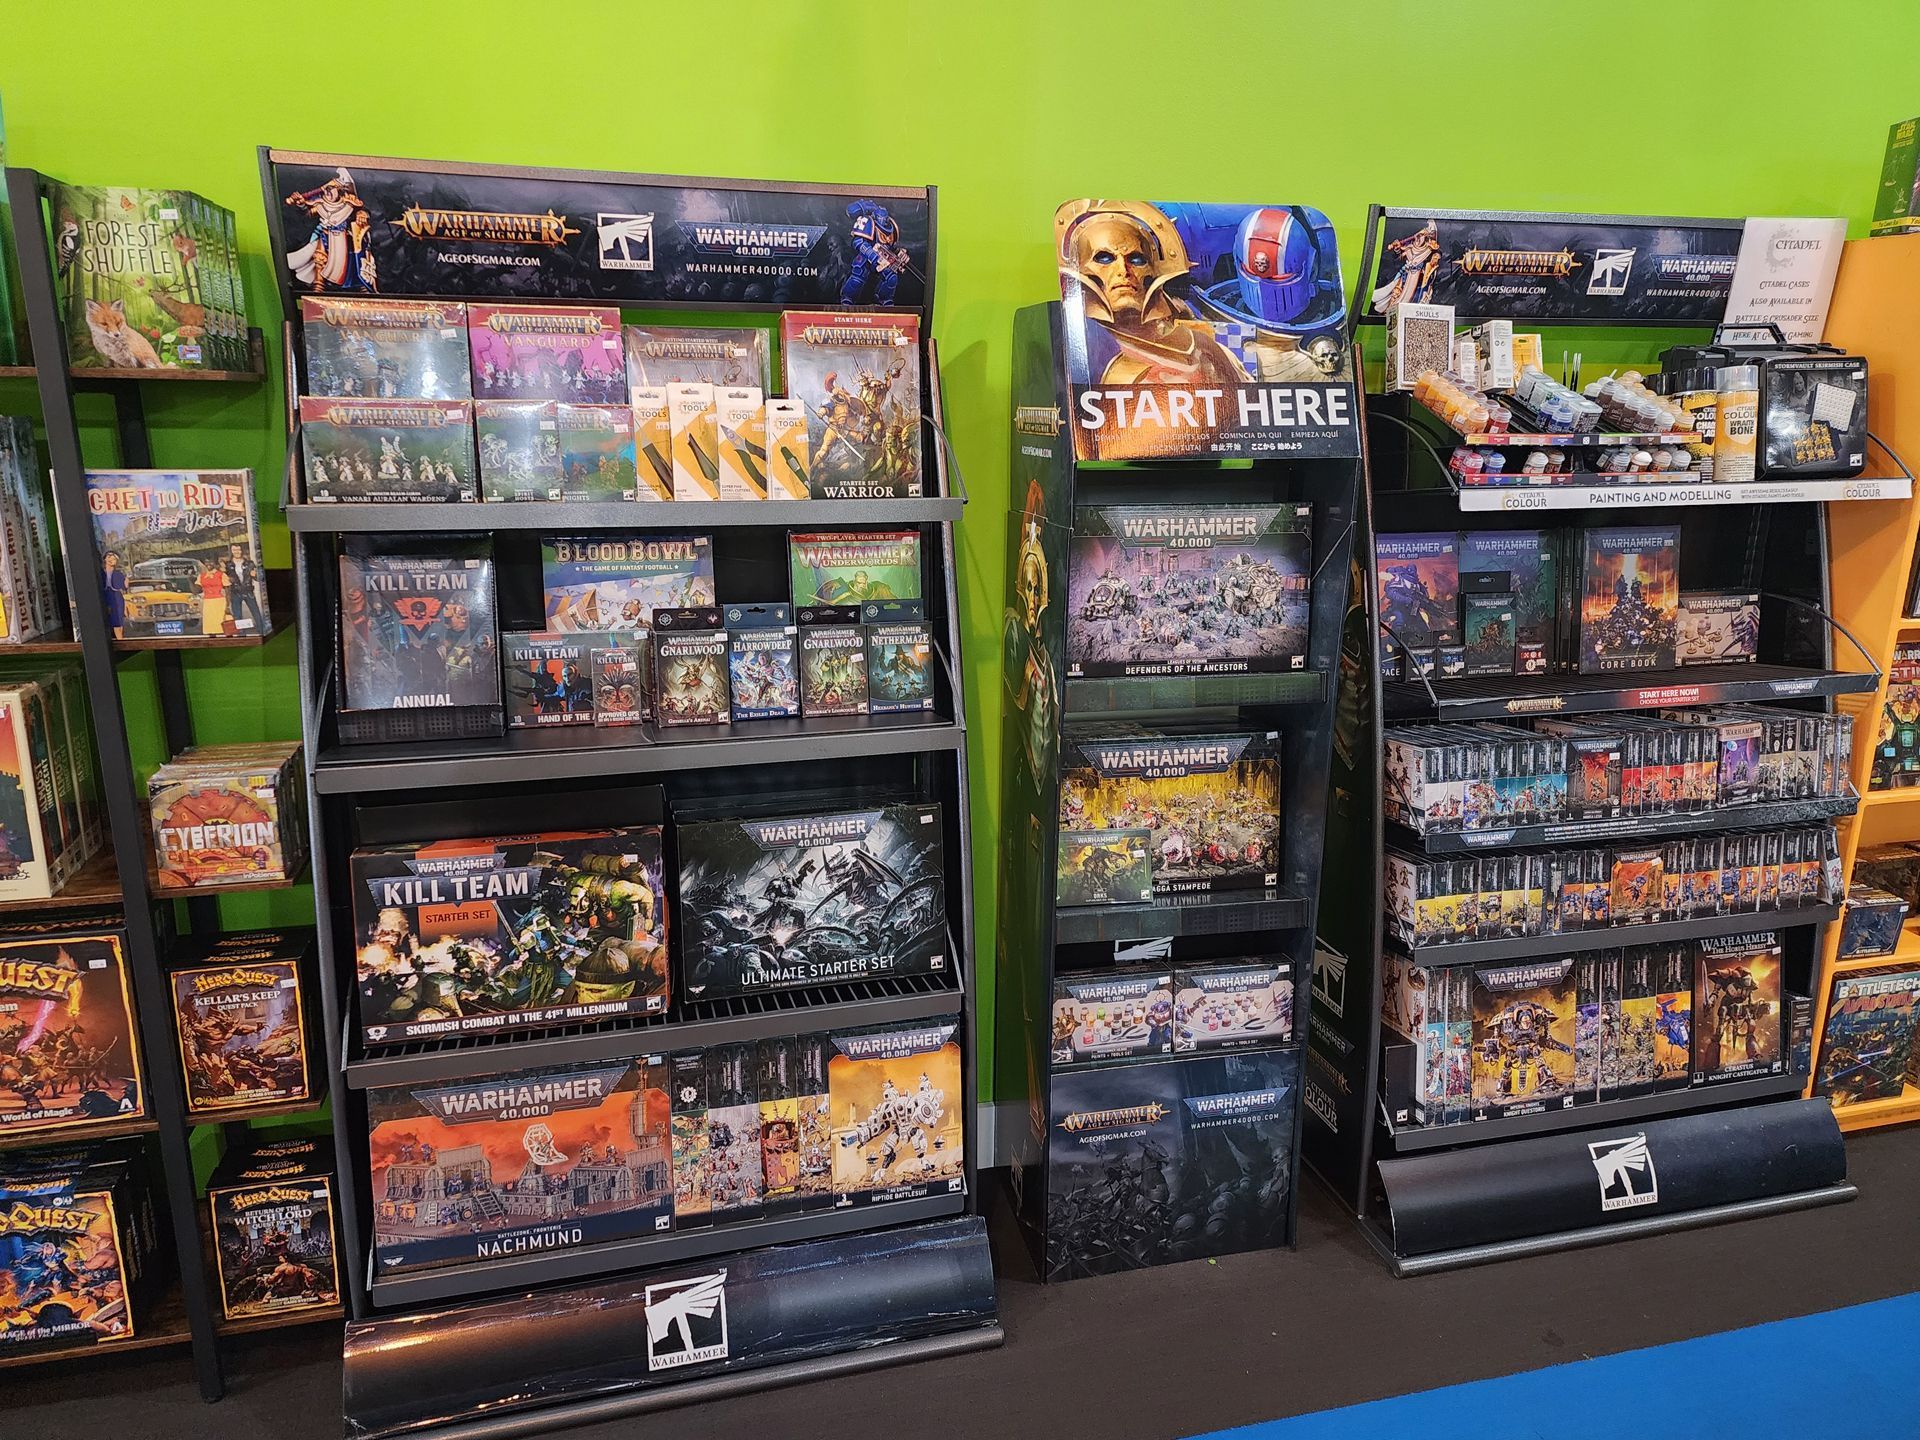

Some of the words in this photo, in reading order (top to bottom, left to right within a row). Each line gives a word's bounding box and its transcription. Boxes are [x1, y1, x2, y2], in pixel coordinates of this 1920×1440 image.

[407, 210, 558, 241] WARHAMMER
[85, 219, 160, 247] FOREST
[695, 227, 808, 248] WARHAMMER
[1774, 239, 1822, 250] CITADEL
[84, 248, 173, 275] SHUFFLE
[437, 252, 541, 267] AGEOFSIGMAR.COM
[601, 261, 652, 269] WARHAMMER
[686, 263, 818, 277] WARHAMMER40000.COM
[1476, 284, 1546, 295] AGEOFSIGMAR.COM
[1759, 280, 1787, 290] CITADEL
[1788, 280, 1810, 290] CASES
[1646, 288, 1731, 298] WARHAMMER40000.C
[1749, 298, 1768, 307] ALSO
[1768, 298, 1804, 307] AVAILABLE
[834, 316, 854, 324] START
[856, 316, 872, 324] HERE
[1415, 310, 1440, 318] SKULLS
[1735, 314, 1762, 324] BATTLE
[1769, 314, 1803, 323] CRUSADER
[1803, 314, 1820, 323] SIZE
[504, 335, 592, 349] VANGUARD
[1080, 387, 1223, 430] START
[1238, 387, 1350, 428] HERE
[1723, 411, 1755, 420] COLOU
[1219, 432, 1255, 440] COMINCIA
[1730, 427, 1754, 435] BONE
[89, 488, 151, 514] CKET
[157, 490, 178, 508] TO
[183, 483, 244, 511] RIDE
[824, 486, 895, 498] WARRIOR
[1589, 493, 1641, 504] PAINTING
[1643, 492, 1667, 502] AND
[1670, 490, 1731, 501] MODELLING
[1846, 488, 1881, 498] COLOUR
[1505, 498, 1548, 508] COLOUR
[147, 512, 179, 532] New
[184, 511, 235, 533] York
[1122, 516, 1257, 538] WARHAMMER
[1475, 539, 1538, 551] WARHAMMER
[1602, 537, 1663, 549] WARHAMMER
[554, 540, 624, 563] BLOOD
[628, 538, 699, 563] BOWL
[389, 561, 444, 570] WARHAMMER
[822, 558, 899, 567] UNDERWORLDS
[365, 573, 409, 592] KILL
[411, 573, 468, 591] TEAM
[1689, 599, 1742, 609] WARHAMMER
[733, 639, 793, 652] HARROWDEEP
[803, 636, 864, 650] GNARLWOOD
[871, 633, 930, 646] NETHERMAZE
[515, 648, 543, 660] KILL
[545, 648, 579, 659] TEAM
[660, 643, 725, 657] GNARLWOOD
[597, 656, 613, 665] KILL
[614, 656, 635, 664] TEAM
[1600, 660, 1625, 670] CORE
[1631, 658, 1657, 668] BOOK
[1125, 665, 1172, 675] DEFENDERS
[1173, 664, 1185, 673] OF
[1186, 664, 1202, 672] THE
[1203, 662, 1248, 672] ANCESTORS
[1639, 689, 1660, 699] START
[1661, 688, 1679, 698] HERE
[1680, 687, 1699, 697] NOW!
[393, 694, 454, 708] ANNUAL
[537, 715, 561, 723] HAND
[562, 714, 573, 722] OF
[574, 713, 590, 721] THE
[1578, 742, 1617, 750] WARHAMMER
[1100, 747, 1230, 769] WARHAMMER
[159, 821, 275, 852] CYBERION
[759, 819, 866, 843] WARHAMMER
[1077, 835, 1119, 845] WARHAMMER
[1467, 834, 1510, 843] WARHAMMER
[417, 857, 495, 874] WARHAMMER
[383, 878, 445, 906] KILL
[450, 872, 529, 901] TEAM
[425, 911, 470, 924] STARTER
[472, 909, 491, 920] SET
[742, 966, 805, 986] ULTIMATE
[810, 958, 868, 977] STARTER
[871, 955, 895, 970] SET
[1488, 966, 1563, 986] WARHAMMER
[1202, 974, 1270, 990] WARHAMMER
[1838, 977, 1920, 999] BATTLETECH
[1078, 983, 1148, 999] WARHAMMER
[194, 993, 250, 1007] KELLAR'S
[251, 990, 281, 1000] KEEP
[217, 1003, 239, 1011] QUEST
[406, 1020, 459, 1036] SKIRMISH
[462, 1015, 506, 1030] COMBAT
[508, 1013, 520, 1024] IN
[522, 1011, 543, 1022] THE
[566, 1002, 628, 1017] MILLENNIUM
[848, 1033, 942, 1055] WARHAMMER
[1708, 1071, 1732, 1081] KNIGHT
[1733, 1068, 1768, 1078] CASTIGATOR
[1724, 1063, 1754, 1073] CERASTUS
[441, 1078, 603, 1115] WARHAMMER
[1196, 1092, 1275, 1112] WARHAMMER
[1305, 1087, 1338, 1127] OLOUR
[2, 1111, 31, 1122] World
[32, 1110, 43, 1119] of
[43, 1107, 74, 1118] Magic
[1190, 1113, 1279, 1130] WARHAMMER40000.COM
[1079, 1129, 1147, 1144] AGEOFSIGMAR.COM
[871, 1193, 893, 1202] RIPTIDE
[894, 1189, 928, 1200] BATTLESUIT
[1603, 1194, 1657, 1209] WARHAMMER
[234, 1213, 276, 1226] WITCH
[279, 1208, 312, 1220] LORD
[245, 1208, 275, 1217] RETURN
[477, 1228, 583, 1258] NACHMUND
[52, 1321, 91, 1332] MIRROR
[650, 1347, 726, 1368] WARHAMMER
